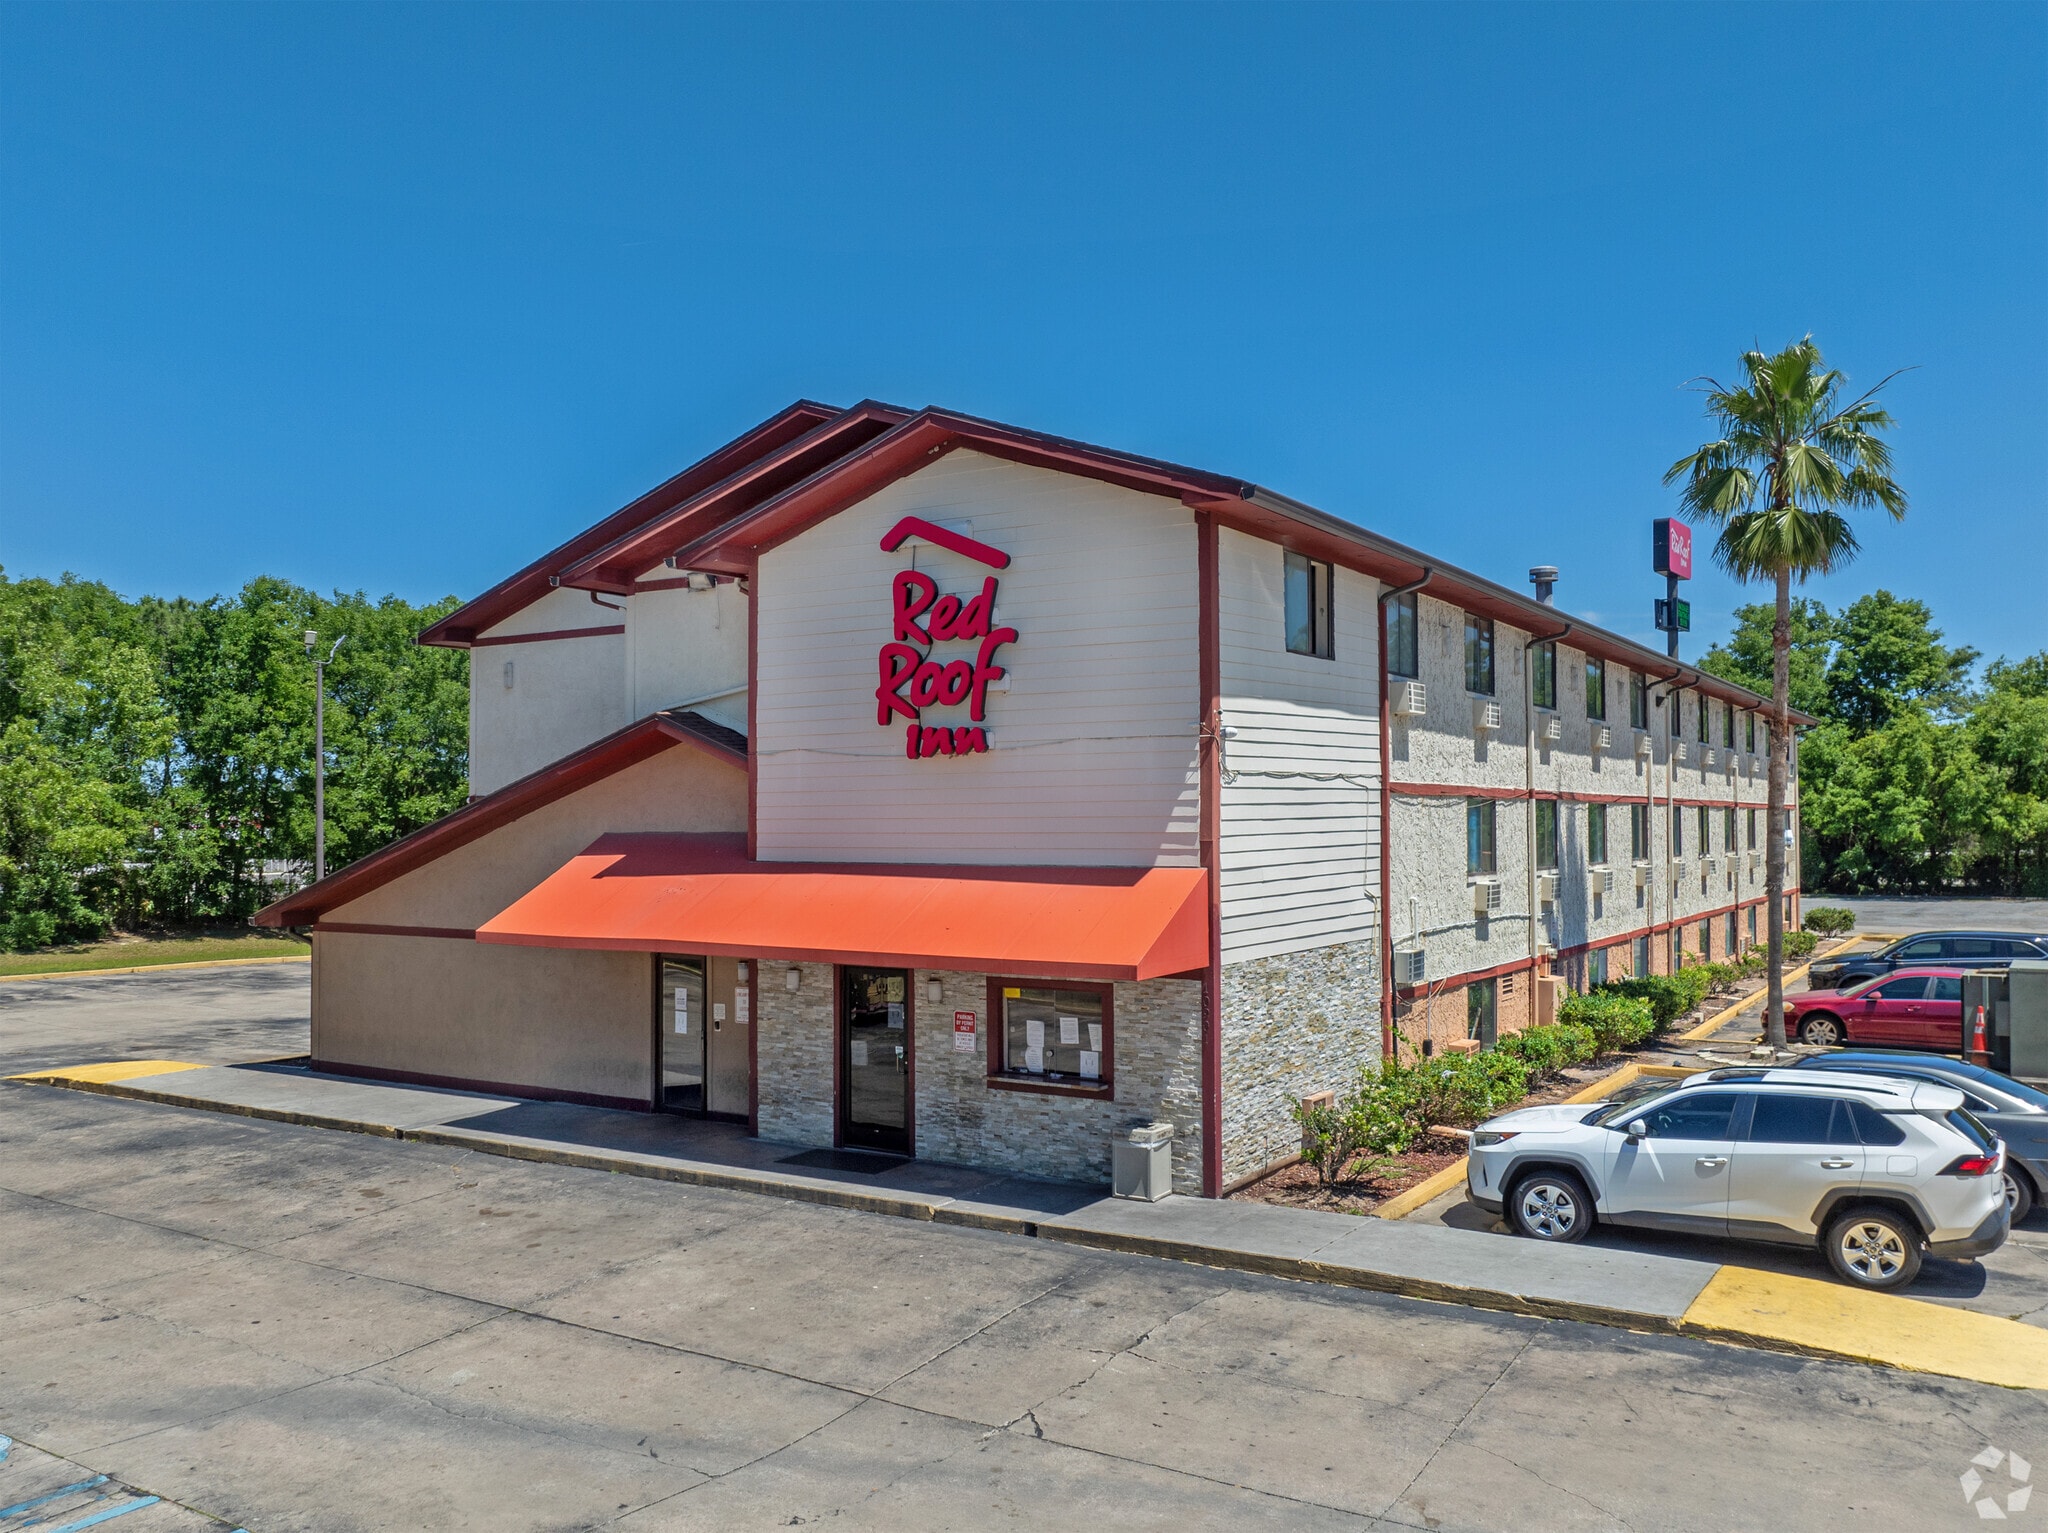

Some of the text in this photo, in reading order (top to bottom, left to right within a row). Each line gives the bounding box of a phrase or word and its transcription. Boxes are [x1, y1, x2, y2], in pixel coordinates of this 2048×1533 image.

[893, 570, 998, 646] Red
[875, 627, 1019, 726] Roof
[906, 723, 990, 760] inn
